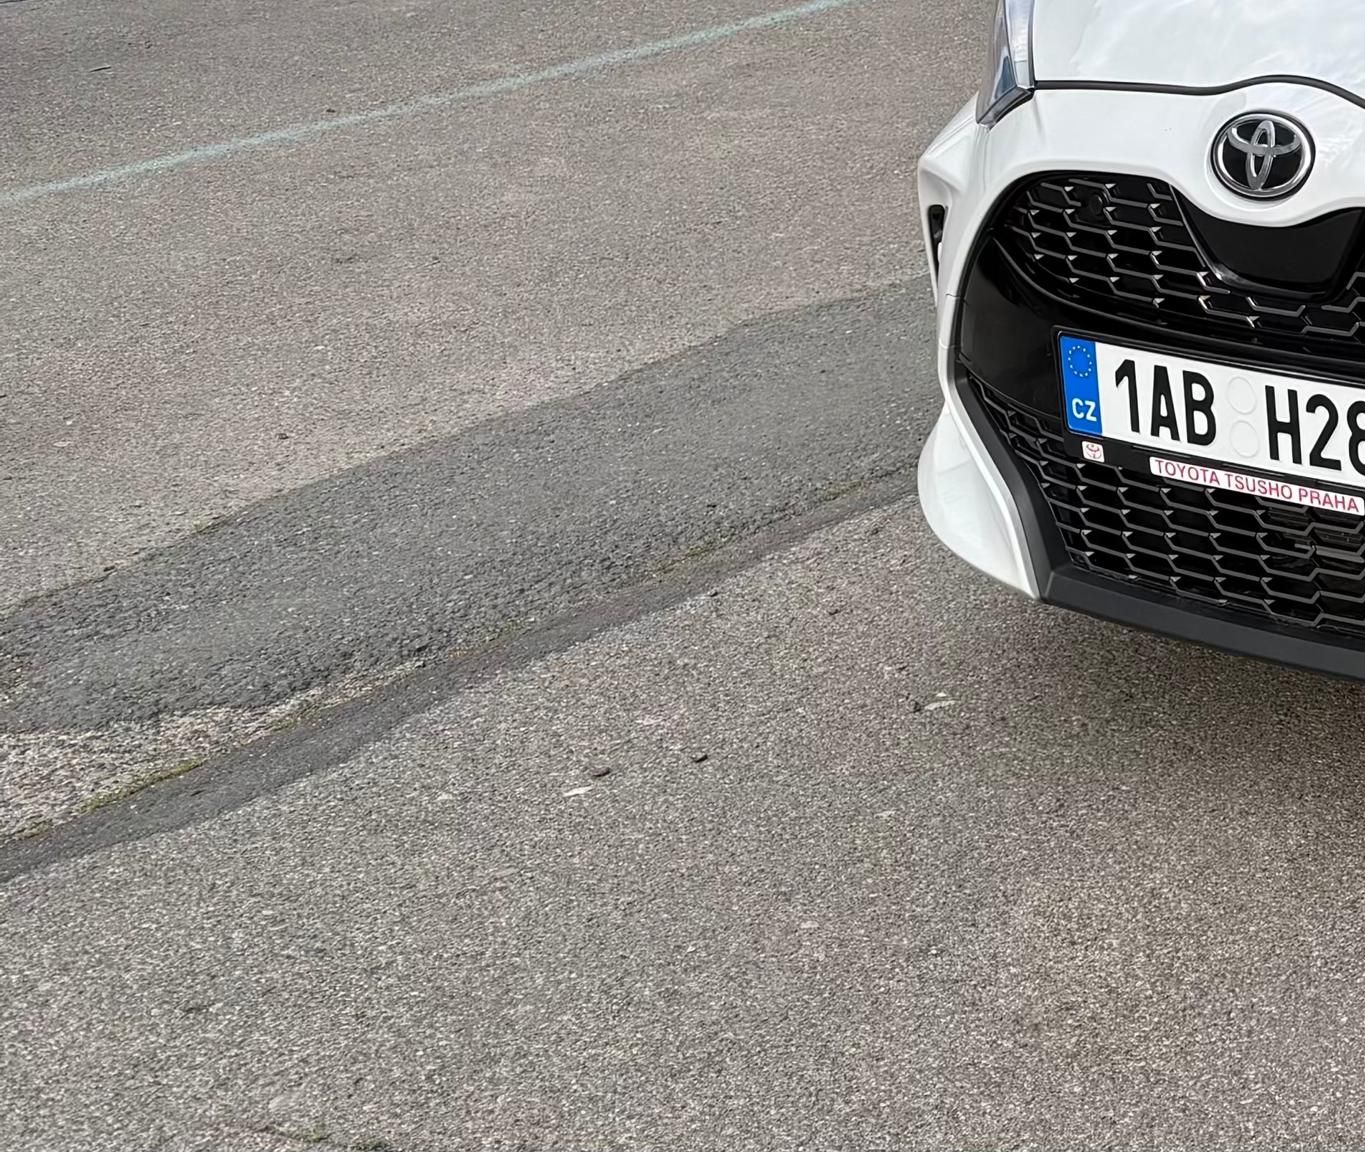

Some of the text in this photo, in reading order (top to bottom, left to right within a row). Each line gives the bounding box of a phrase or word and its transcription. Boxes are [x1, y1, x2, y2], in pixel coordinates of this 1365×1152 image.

[1071, 397, 1097, 422] CZ
[1115, 359, 1217, 446] 1AB
[1155, 459, 1360, 513] TOYOTA TSUSHO PRAHA
